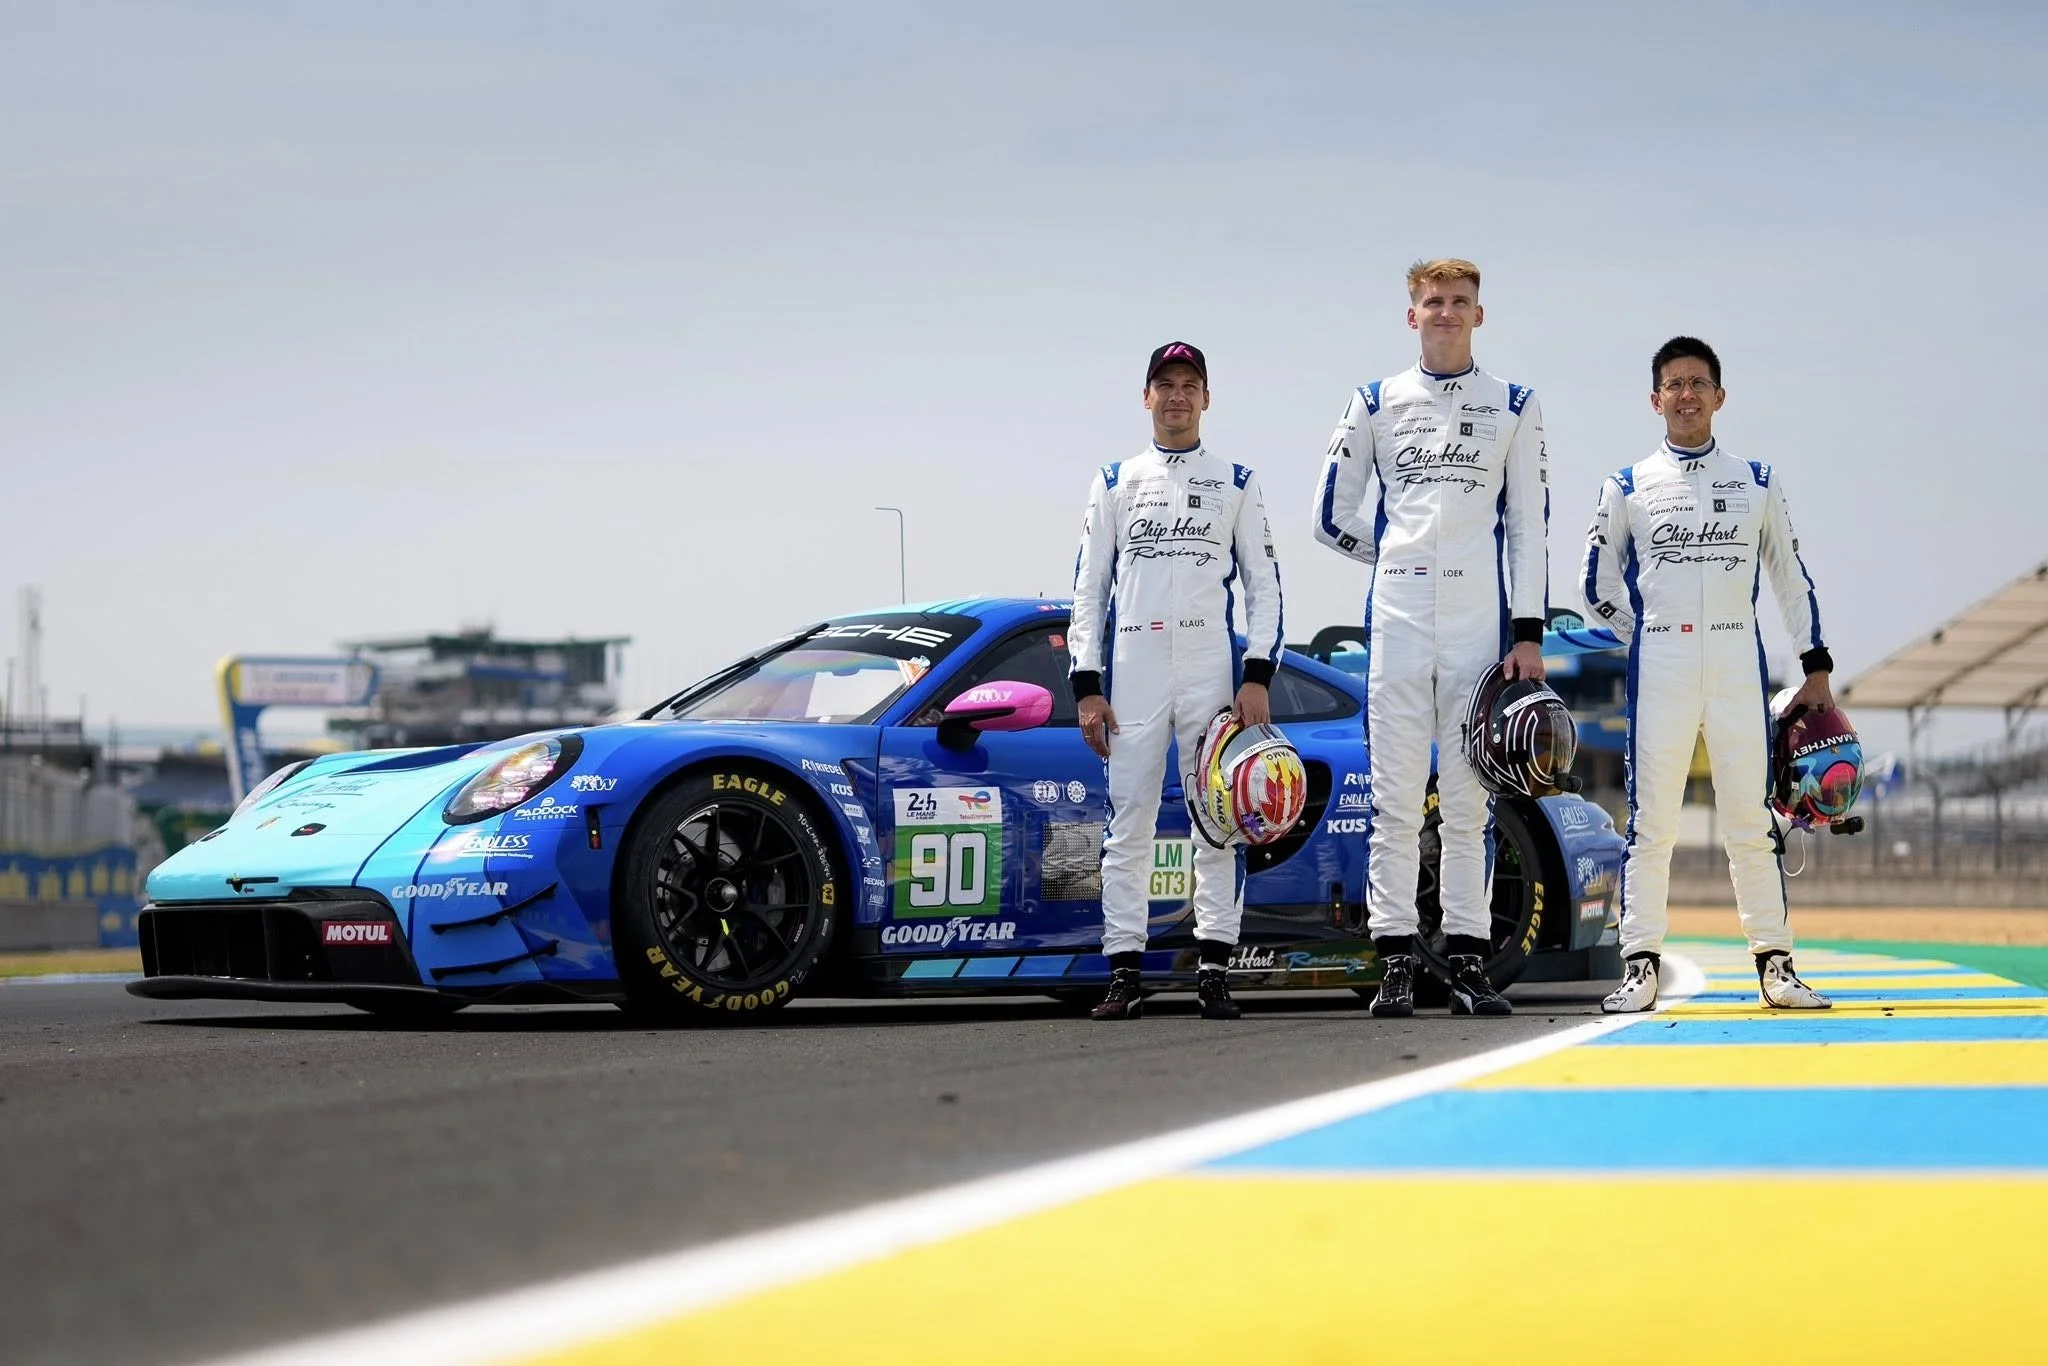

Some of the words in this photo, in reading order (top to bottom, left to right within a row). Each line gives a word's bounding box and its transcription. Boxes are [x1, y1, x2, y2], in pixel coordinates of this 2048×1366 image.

[1461, 403, 1500, 415] WEC
[1401, 416, 1432, 424] MANTHEY
[1394, 427, 1438, 437] GOODYEAR
[1396, 446, 1436, 470] Chip
[1439, 443, 1480, 463] Hart
[1188, 477, 1225, 489] WEC
[1396, 473, 1485, 493] Racing
[1712, 481, 1747, 489] WEC
[1128, 501, 1168, 512] GODYEAR
[1650, 505, 1694, 516] GOODYEAR
[1129, 518, 1168, 544] Chip
[1171, 517, 1212, 536] Hart
[1651, 523, 1694, 549] Chip
[1697, 521, 1738, 542] Hart
[1125, 546, 1218, 566] Racing
[1651, 551, 1747, 571] Racing
[1443, 569, 1464, 577] LOEK
[1120, 625, 1143, 633] HRX
[1179, 619, 1205, 628] KLAUS
[1647, 625, 1671, 633] HRX
[1710, 622, 1744, 631] ANTARES
[806, 624, 952, 648] SCHE
[1266, 751, 1290, 761] PAMO
[1793, 733, 1853, 759] MANTHEY
[573, 775, 617, 791] KW
[712, 774, 787, 806] EAGLE
[1033, 781, 1058, 801] FIA
[1215, 789, 1226, 824] PAMO
[1339, 793, 1372, 805] ENDLE
[514, 805, 578, 817] PADDOCK
[1559, 806, 1588, 826] ENDLESS
[465, 834, 531, 849] ENDLESS
[1154, 844, 1183, 868] LM
[909, 831, 987, 908] 90
[392, 878, 508, 900] GOODYEAR
[1150, 871, 1185, 896] GT3
[1520, 881, 1544, 956] EAGLE
[1581, 903, 1604, 920] MOTUL
[326, 924, 389, 942] MOTUL
[882, 917, 1016, 948] GOODYEAR
[1238, 946, 1274, 968] Hart
[1281, 951, 1368, 974] Racing
[646, 945, 789, 1011] GOODYEAR
